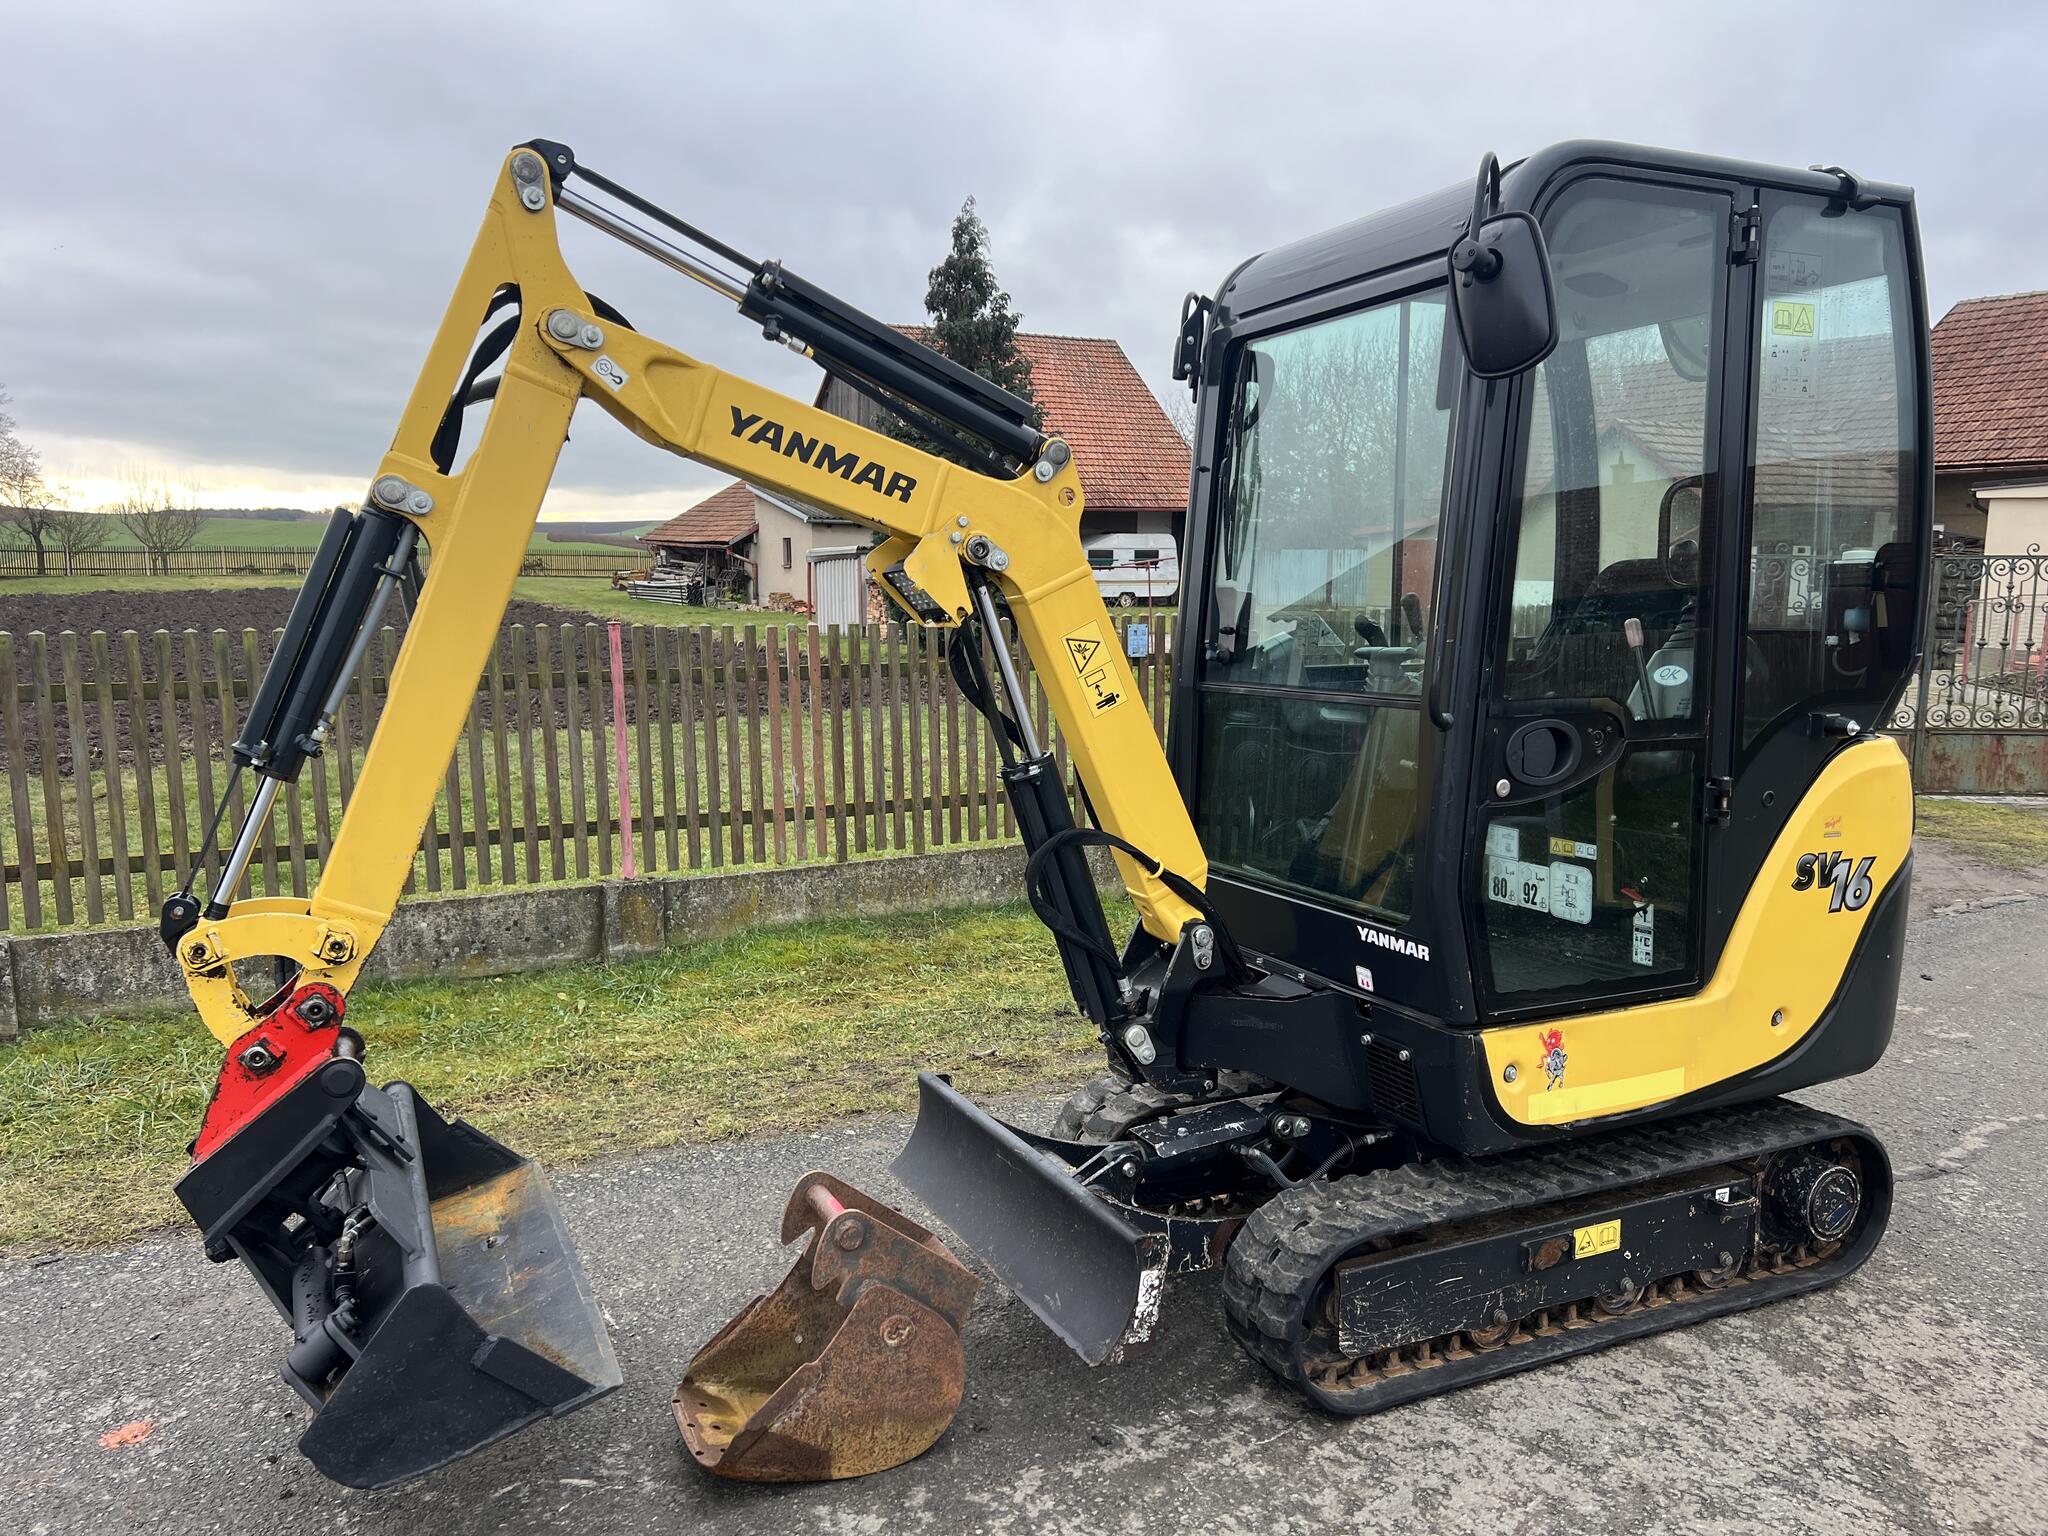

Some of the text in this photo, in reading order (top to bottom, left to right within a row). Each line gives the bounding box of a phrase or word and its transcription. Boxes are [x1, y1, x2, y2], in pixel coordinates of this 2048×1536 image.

[730, 405, 918, 504] YANMAR
[1659, 667, 1681, 681] OK
[1493, 876, 1508, 899] 80
[1523, 882, 1538, 906] 92
[1791, 851, 1877, 913] SV16
[1356, 925, 1430, 962] YANMAR
